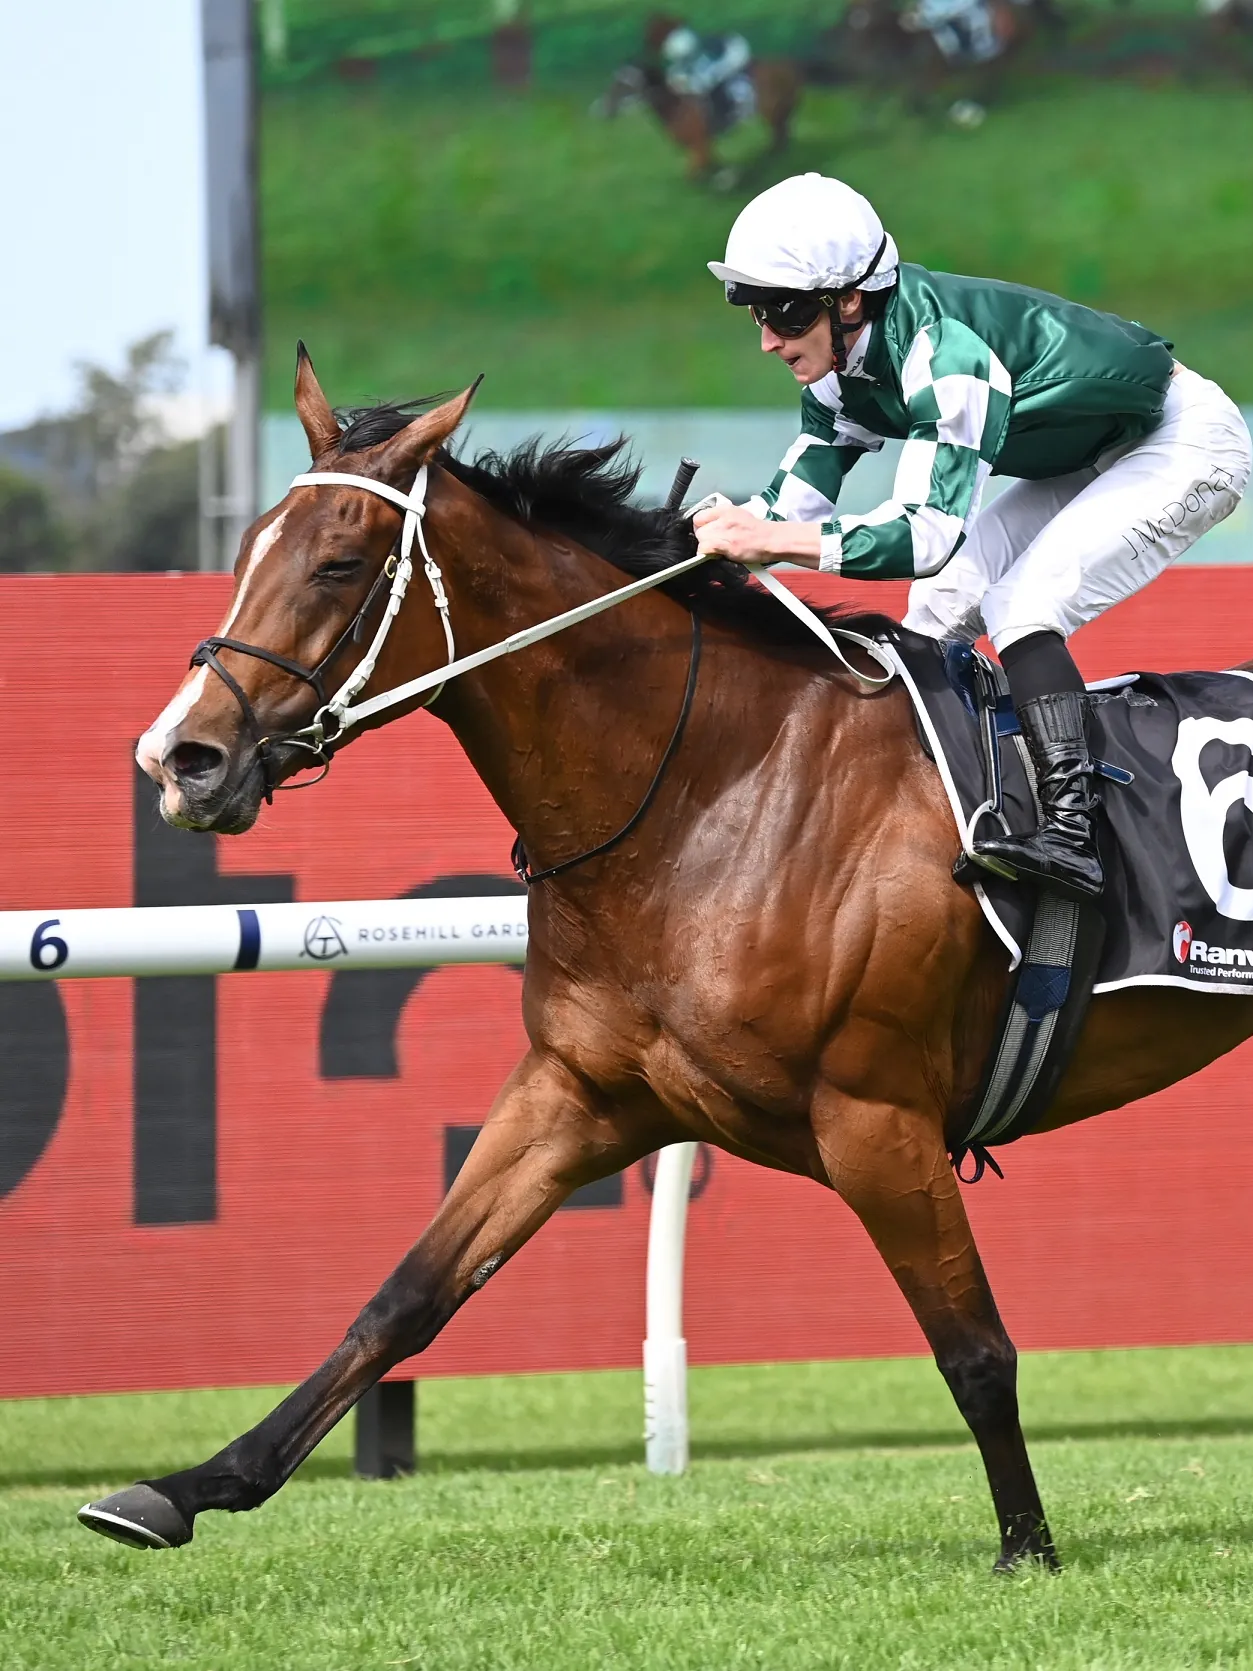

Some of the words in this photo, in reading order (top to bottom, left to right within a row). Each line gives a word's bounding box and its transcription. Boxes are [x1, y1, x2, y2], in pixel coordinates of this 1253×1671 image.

[358, 926, 461, 942] ROSEHILL
[30, 919, 69, 971] 6
[1190, 964, 1216, 977] Trusted
